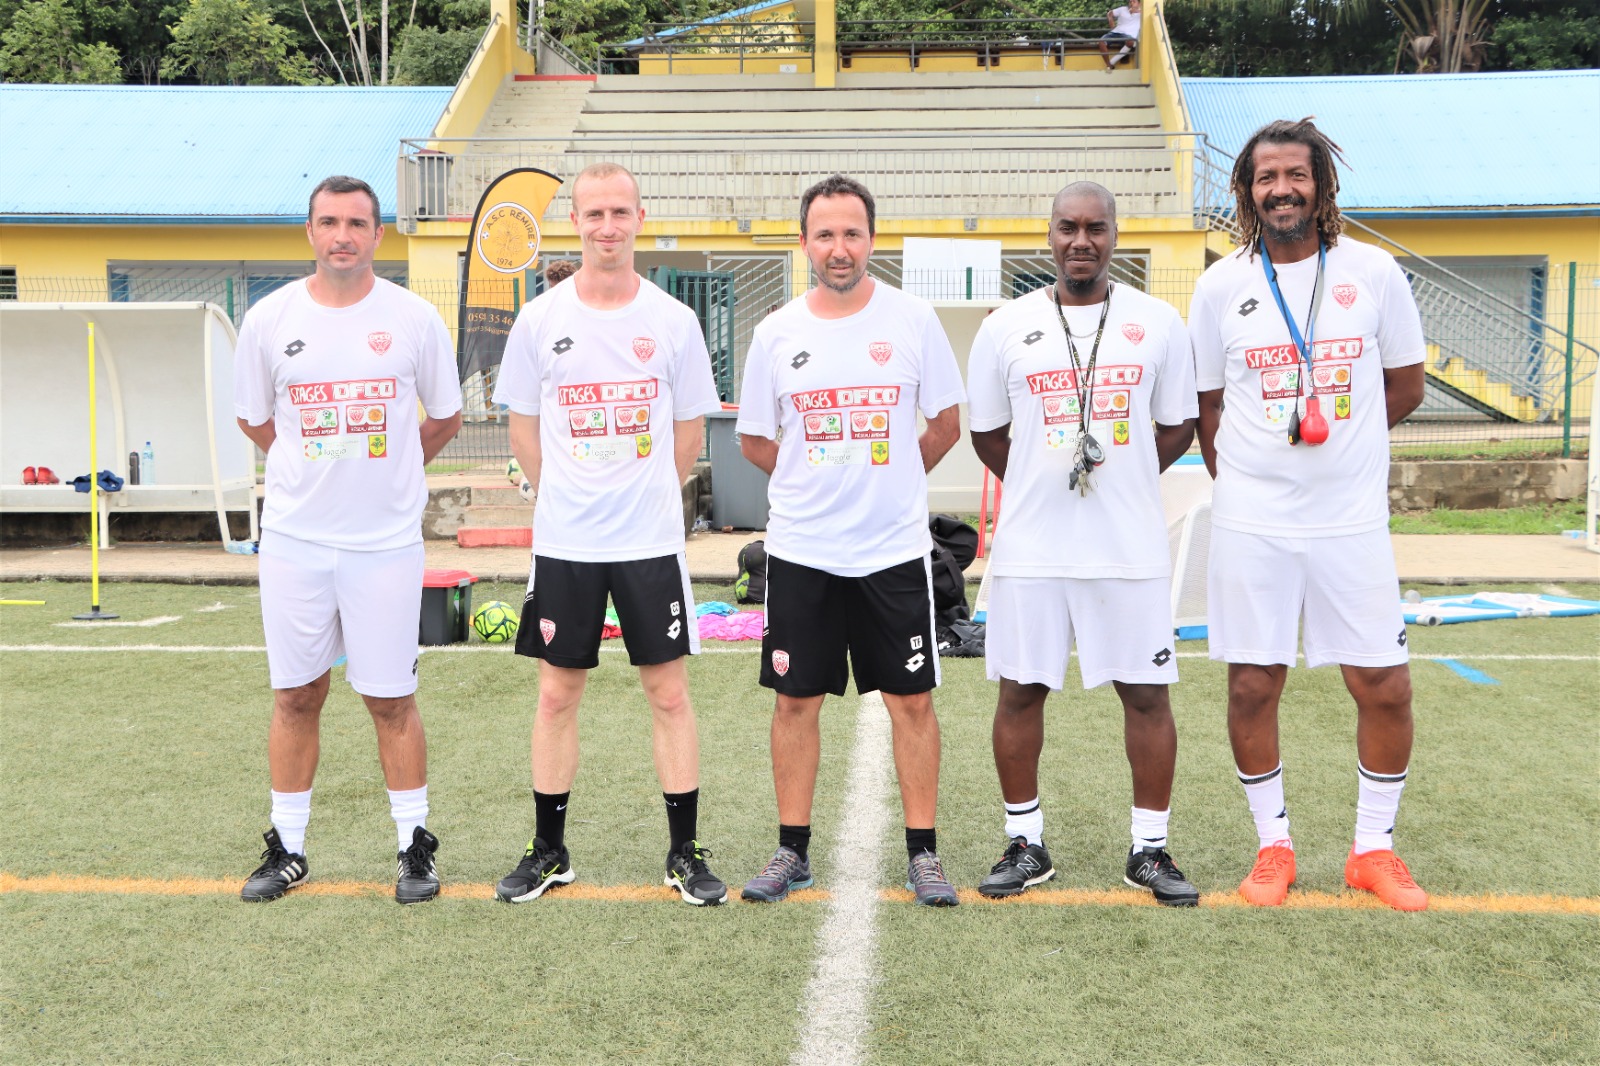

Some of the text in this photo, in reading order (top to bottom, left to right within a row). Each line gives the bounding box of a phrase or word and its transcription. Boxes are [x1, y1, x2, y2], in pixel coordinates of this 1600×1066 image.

[510, 210, 535, 239] RÉMIRE
[497, 257, 512, 267] 1974
[489, 313, 500, 323] 35
[502, 316, 513, 326] 46
[1247, 347, 1293, 367] STAGES
[1029, 368, 1140, 393] STAGES DFCO
[290, 381, 395, 404] STAGES DFCO
[559, 381, 656, 405] STAGES DFCO
[793, 388, 898, 411] STAGES DFCO
